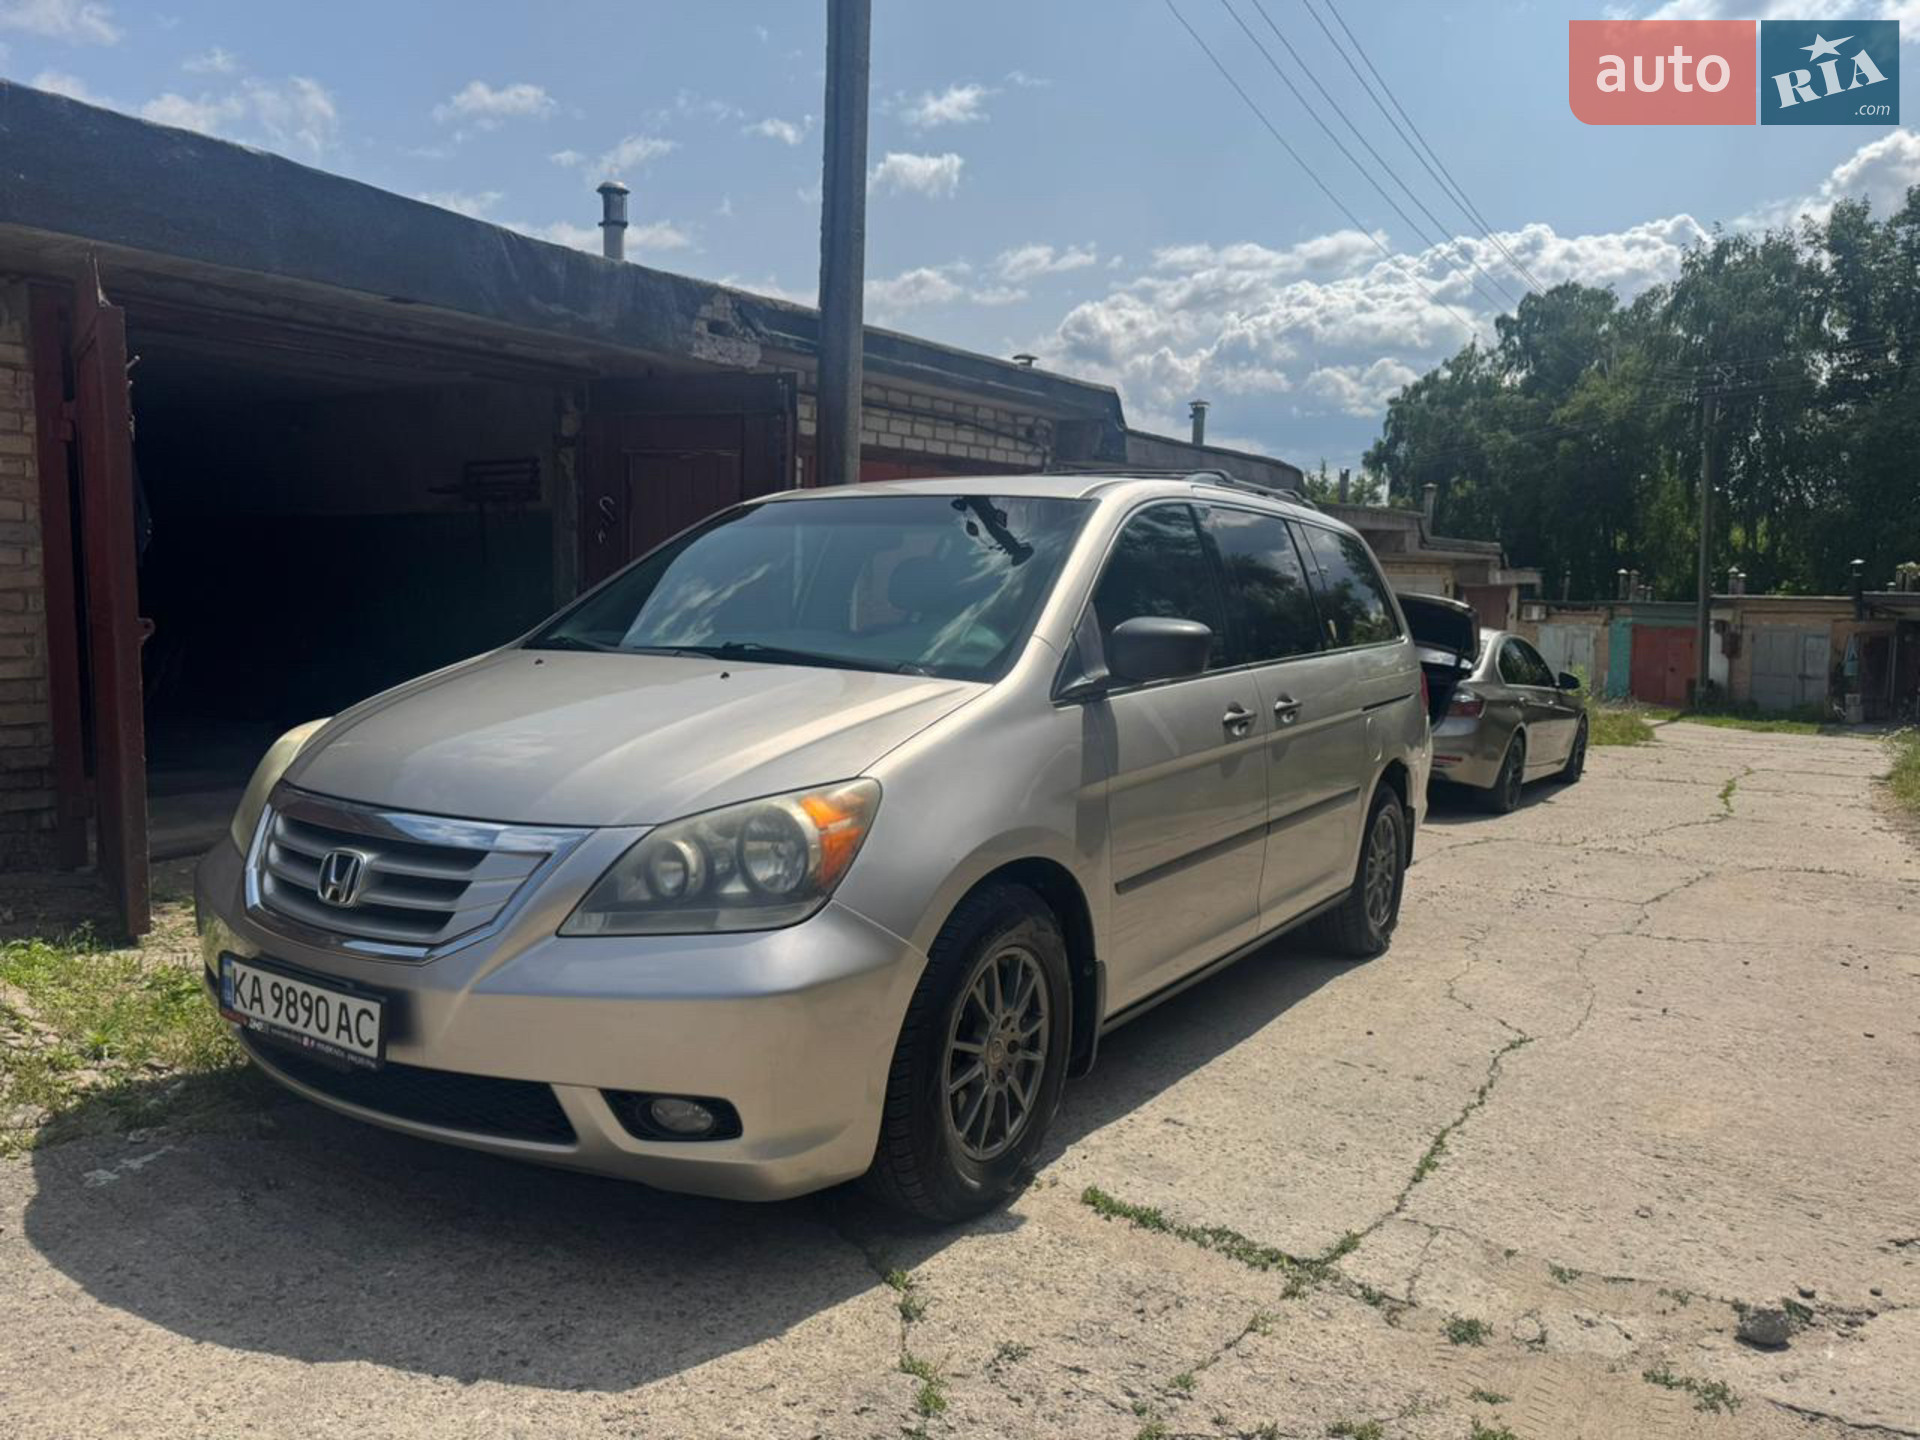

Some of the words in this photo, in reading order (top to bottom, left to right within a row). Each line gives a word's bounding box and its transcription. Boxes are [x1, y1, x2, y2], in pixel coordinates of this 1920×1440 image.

[233, 968, 265, 1015] KA
[270, 982, 330, 1034] 9890
[336, 1002, 376, 1049] AC
